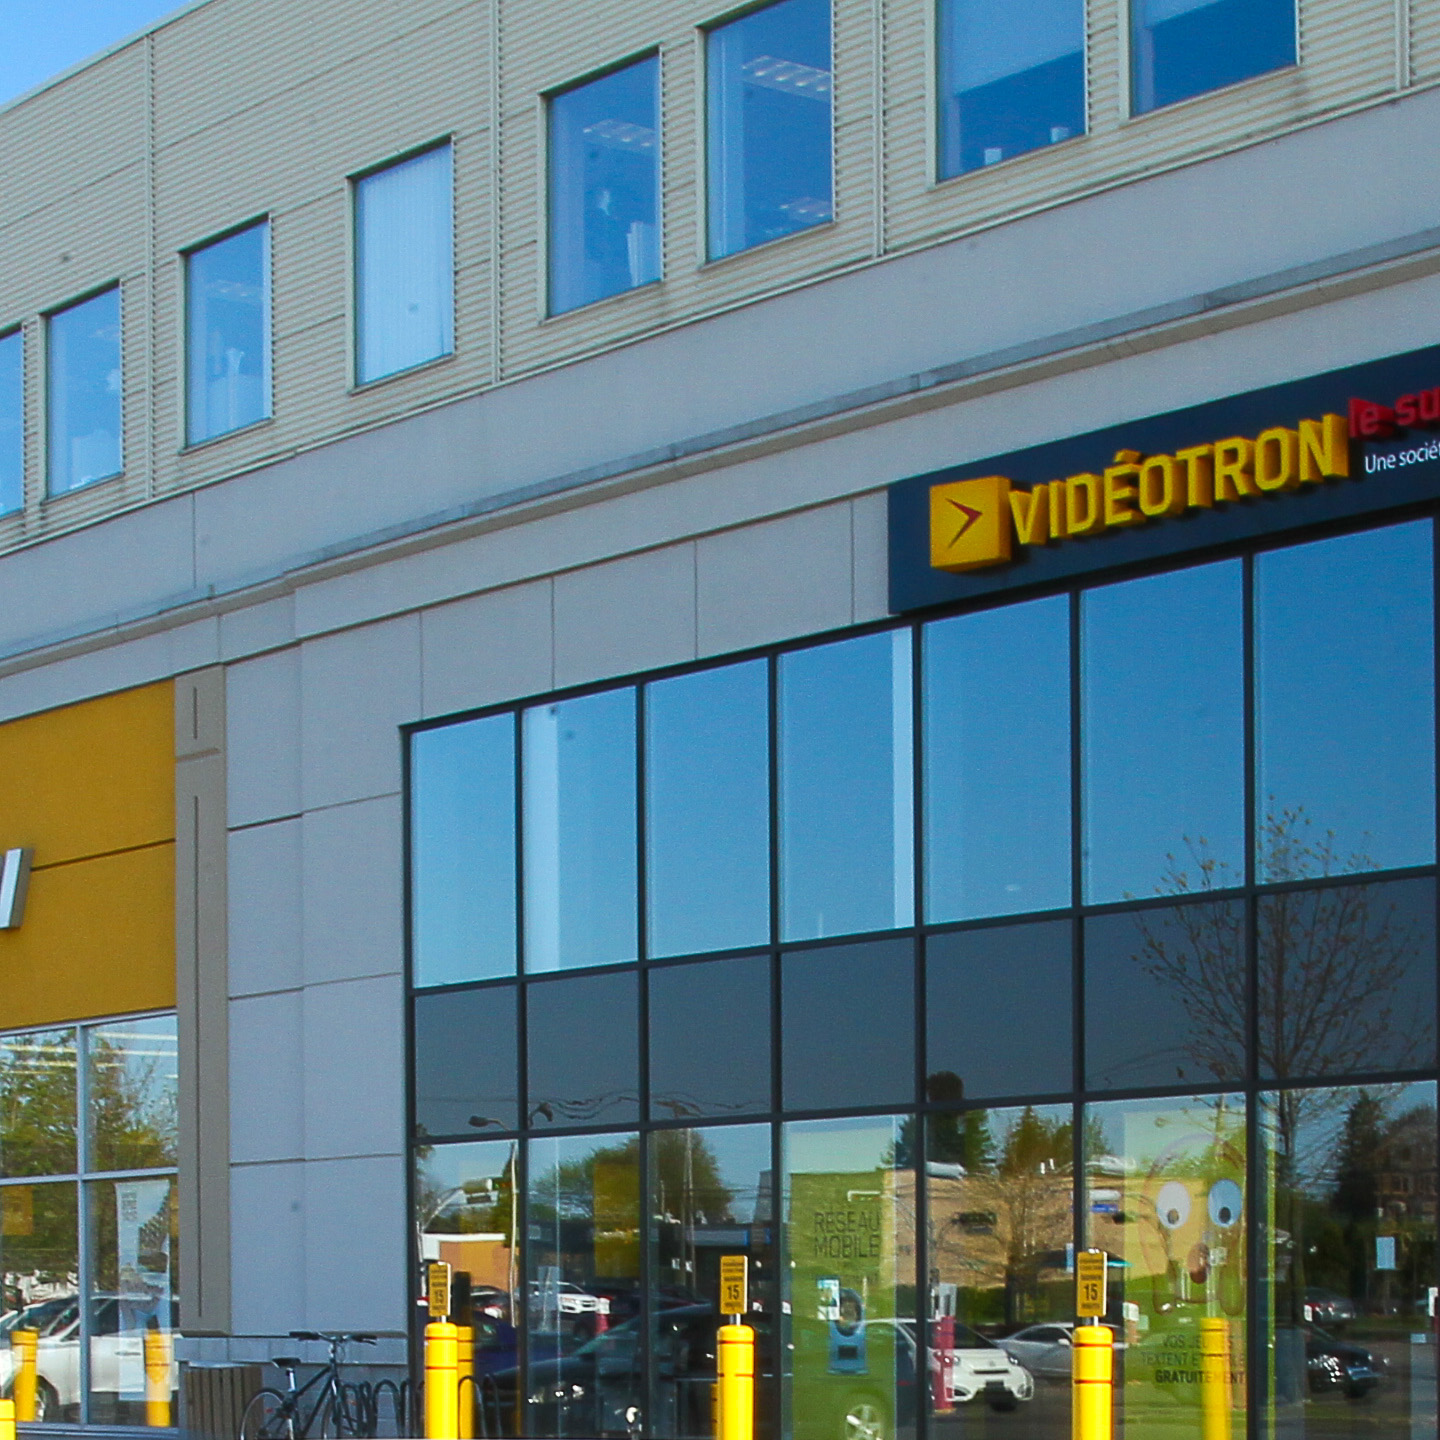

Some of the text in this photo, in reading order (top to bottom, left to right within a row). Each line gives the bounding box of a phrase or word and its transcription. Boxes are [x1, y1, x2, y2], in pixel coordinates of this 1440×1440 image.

[1347, 396, 1389, 439] le
[1364, 453, 1397, 474] Une
[1008, 413, 1348, 546] VIDÉOTRON
[814, 1234, 880, 1258] MOBILE
[727, 1284, 740, 1300] 15
[1084, 1283, 1098, 1301] 15
